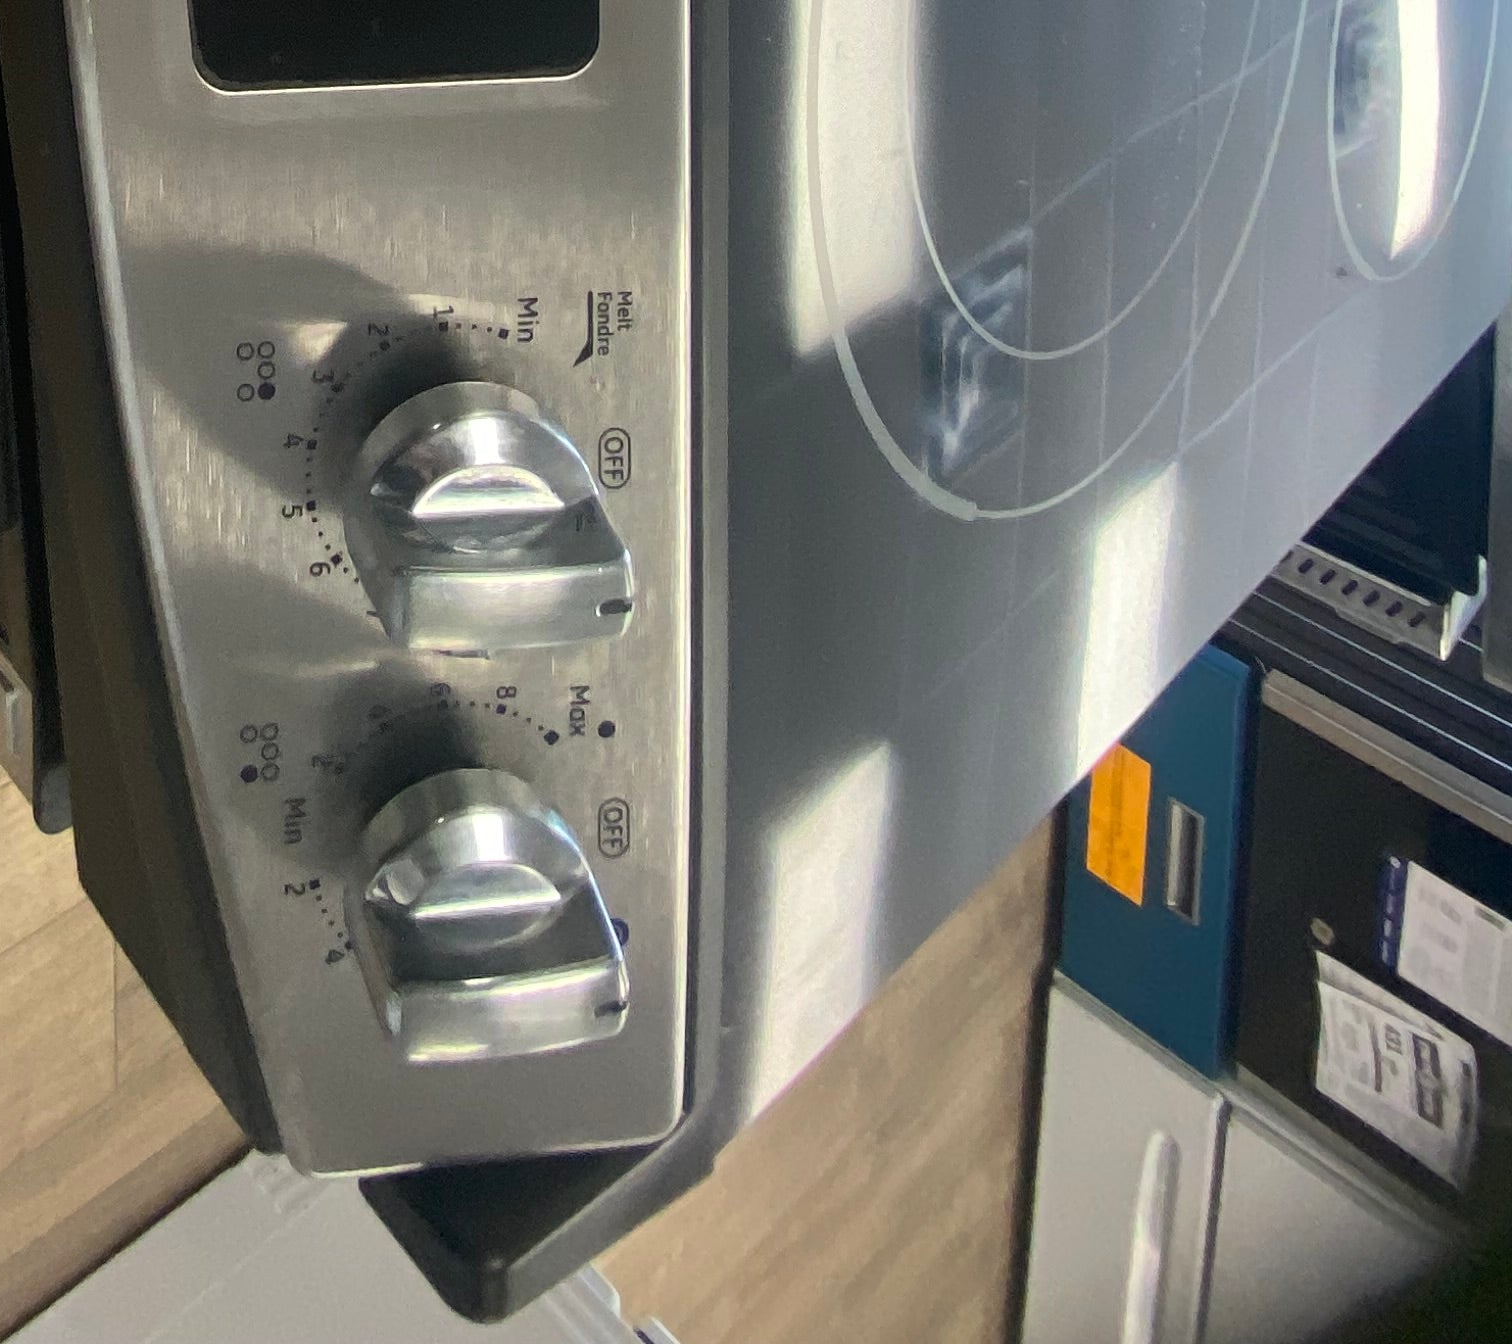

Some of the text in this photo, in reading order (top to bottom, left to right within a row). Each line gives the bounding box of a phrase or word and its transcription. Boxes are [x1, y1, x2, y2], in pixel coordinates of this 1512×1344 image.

[431, 304, 456, 320] 1
[616, 290, 633, 332] Melt
[516, 296, 540, 344] Min
[596, 291, 614, 357] Fondre
[366, 322, 391, 338] 2
[310, 369, 335, 385] 3
[282, 432, 305, 449] 4
[603, 435, 625, 482] OFF
[281, 503, 305, 520] 5
[308, 561, 332, 578] 6
[495, 685, 517, 700] 8
[568, 685, 592, 738] Max
[283, 796, 307, 846] Min
[601, 806, 625, 850] OFF
[283, 882, 306, 897] 2
